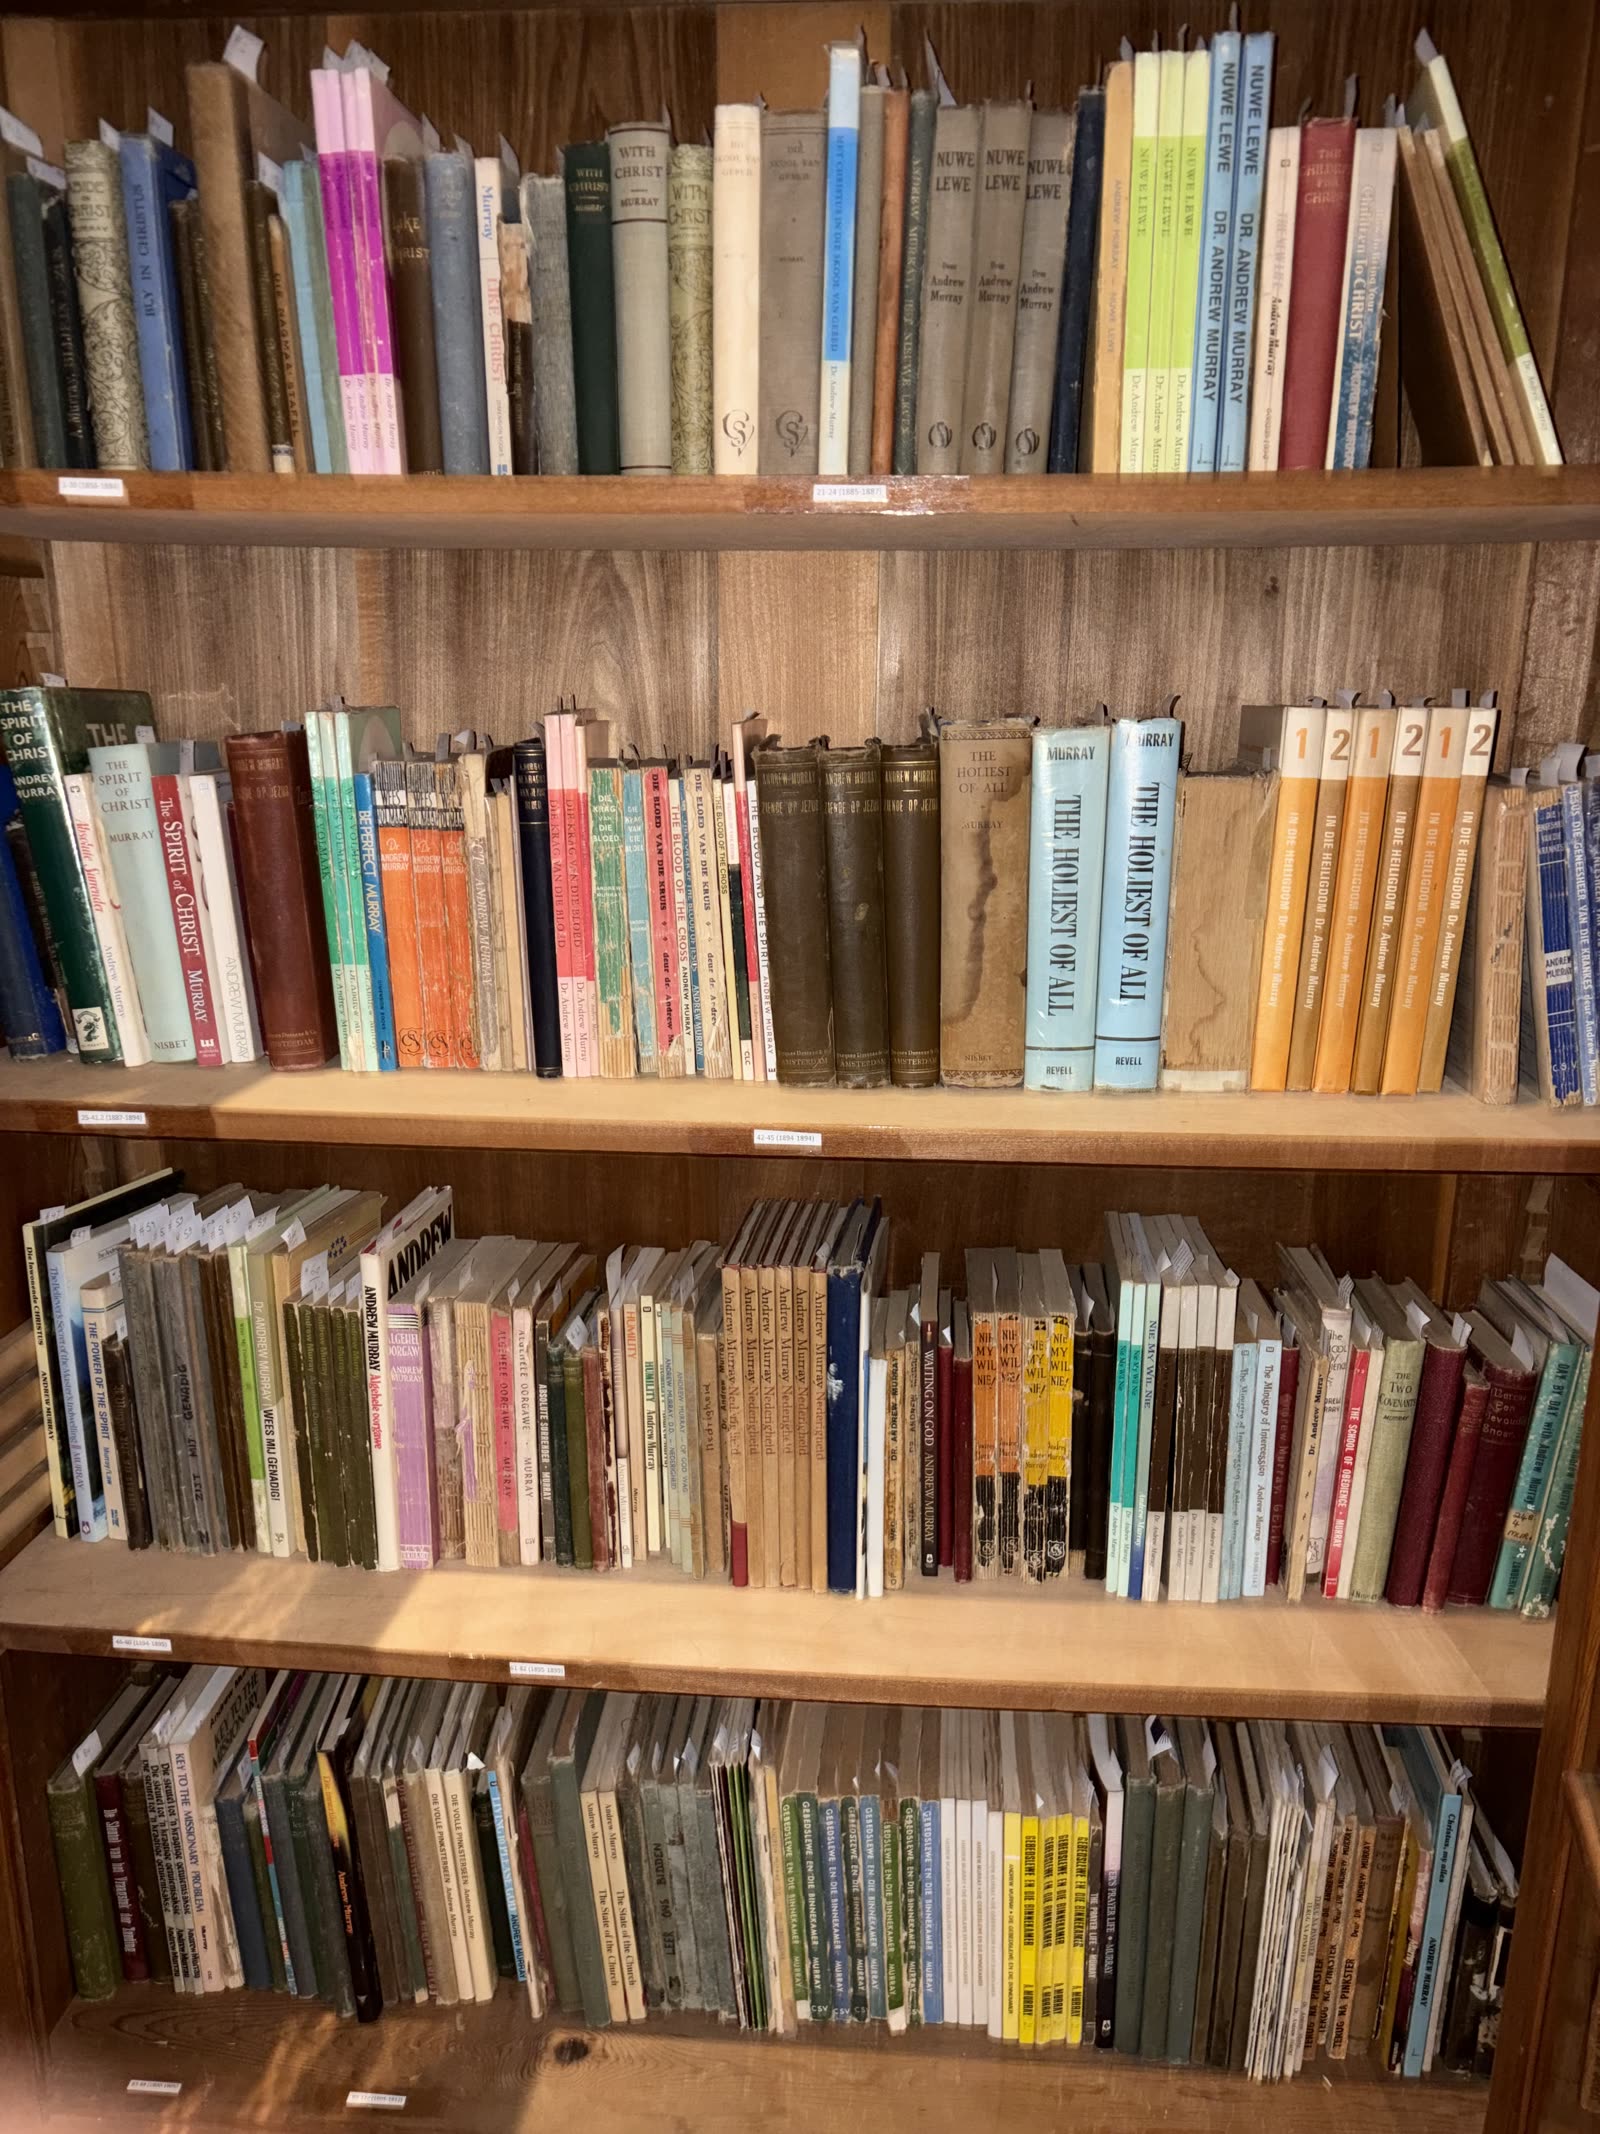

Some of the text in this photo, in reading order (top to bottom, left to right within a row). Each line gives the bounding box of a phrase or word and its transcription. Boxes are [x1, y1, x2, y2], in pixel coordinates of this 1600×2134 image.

[619, 146, 656, 159] WITH
[936, 152, 975, 167] NUWE
[986, 150, 1025, 166] NUWE
[614, 166, 663, 179] CHRIST
[936, 176, 971, 192] LEWE
[985, 175, 1021, 191] LEWE
[620, 197, 659, 208] MURRAY
[672, 184, 708, 201] WITH
[132, 184, 150, 257] CHRISTUS
[481, 186, 494, 240] Murray
[668, 205, 712, 226] CHRIST
[1203, 62, 1235, 402] NUWE LEWE DR. ANDREW MURRAY
[1229, 65, 1265, 404] NUWE LEWE DR. ANDREW MURRAY
[140, 264, 151, 287] IN
[931, 275, 965, 287] Andrew
[930, 290, 963, 304] Murray
[488, 323, 503, 383] CHRIST
[3, 700, 33, 712] THE
[1, 716, 47, 730] SPIRIT
[13, 732, 33, 745] OF
[1296, 728, 1308, 759] 1
[1330, 729, 1350, 760] 2
[1368, 727, 1380, 758] 1
[1402, 724, 1423, 756] 2
[1439, 727, 1452, 758] 1
[1470, 724, 1491, 756] 2
[6, 746, 56, 761] CHRIS
[106, 760, 129, 770] THE
[1047, 746, 1096, 761] MURRAY
[98, 772, 142, 785] SPIRIT
[115, 787, 129, 797] OF
[651, 773, 659, 792] DIE
[101, 799, 151, 813] CHRIST
[653, 796, 662, 828] BLOED
[110, 830, 155, 843] MURRAY
[656, 833, 664, 854] VAN
[658, 881, 668, 911] KRUIS
[1119, 782, 1160, 1002] THE HOLIEST OF ALL
[160, 798, 210, 1024] The SPIRIT of CHRIST MURRAY
[365, 883, 382, 933] MURRAY
[1048, 795, 1082, 1017] THE HOLIEST OF ALL
[1370, 811, 1407, 1008] IN DIE HEILIGDOM Dr. Andrew Murray
[661, 952, 670, 978] deur
[663, 979, 671, 992] dr.
[664, 994, 673, 1032] Andrew
[154, 1040, 188, 1050] NISBET
[1046, 1065, 1073, 1076] REVELL
[1115, 1056, 1142, 1066] REVELL
[254, 1301, 265, 1317] Dr.
[87, 1321, 97, 1341] THE
[255, 1318, 268, 1360] ANDREW
[90, 1344, 101, 1375] POWER
[364, 1285, 382, 1450] ANDREW MURRAY Algehele oorgawe
[1264, 1365, 1273, 1381] The
[40, 1371, 50, 1408] ANDREW
[94, 1378, 103, 1390] OF
[259, 1362, 271, 1401] MURRAY
[96, 1392, 105, 1410] THE
[1262, 1382, 1273, 1417] Ministry
[44, 1409, 55, 1441] MURRAY
[99, 1411, 110, 1441] SPIRIT
[264, 1408, 274, 1437] WEES
[268, 1438, 276, 1455] MIJ
[923, 1349, 935, 1543] WAITING ON GOD ANDREW MURRAY
[1255, 1428, 1269, 1476] Intercession
[1332, 1407, 1360, 1549] THE SCHOOL OF OBEDIENCE MURRAY
[1255, 1484, 1265, 1513] Andrew
[1252, 1514, 1263, 1542] Murray
[176, 1753, 204, 1913] KEY TO THE MISSIONARY PROBLEM
[454, 1808, 462, 1832] VOLLE
[586, 1802, 600, 1859] Andrew Murray
[457, 1834, 469, 1885] PINKSTERSEEN
[1438, 1813, 1456, 1883] Christus, my alles
[598, 1889, 607, 1904] The
[802, 1801, 821, 1989] GEBEDSLEWE EN DIE BINNEKAMER MURRAY
[467, 1915, 475, 1939] Murray
[601, 1907, 609, 1929] State
[605, 1940, 613, 1953] the
[607, 1954, 617, 1987] Church
[1421, 1937, 1436, 2007] ANDREW MURRAY
